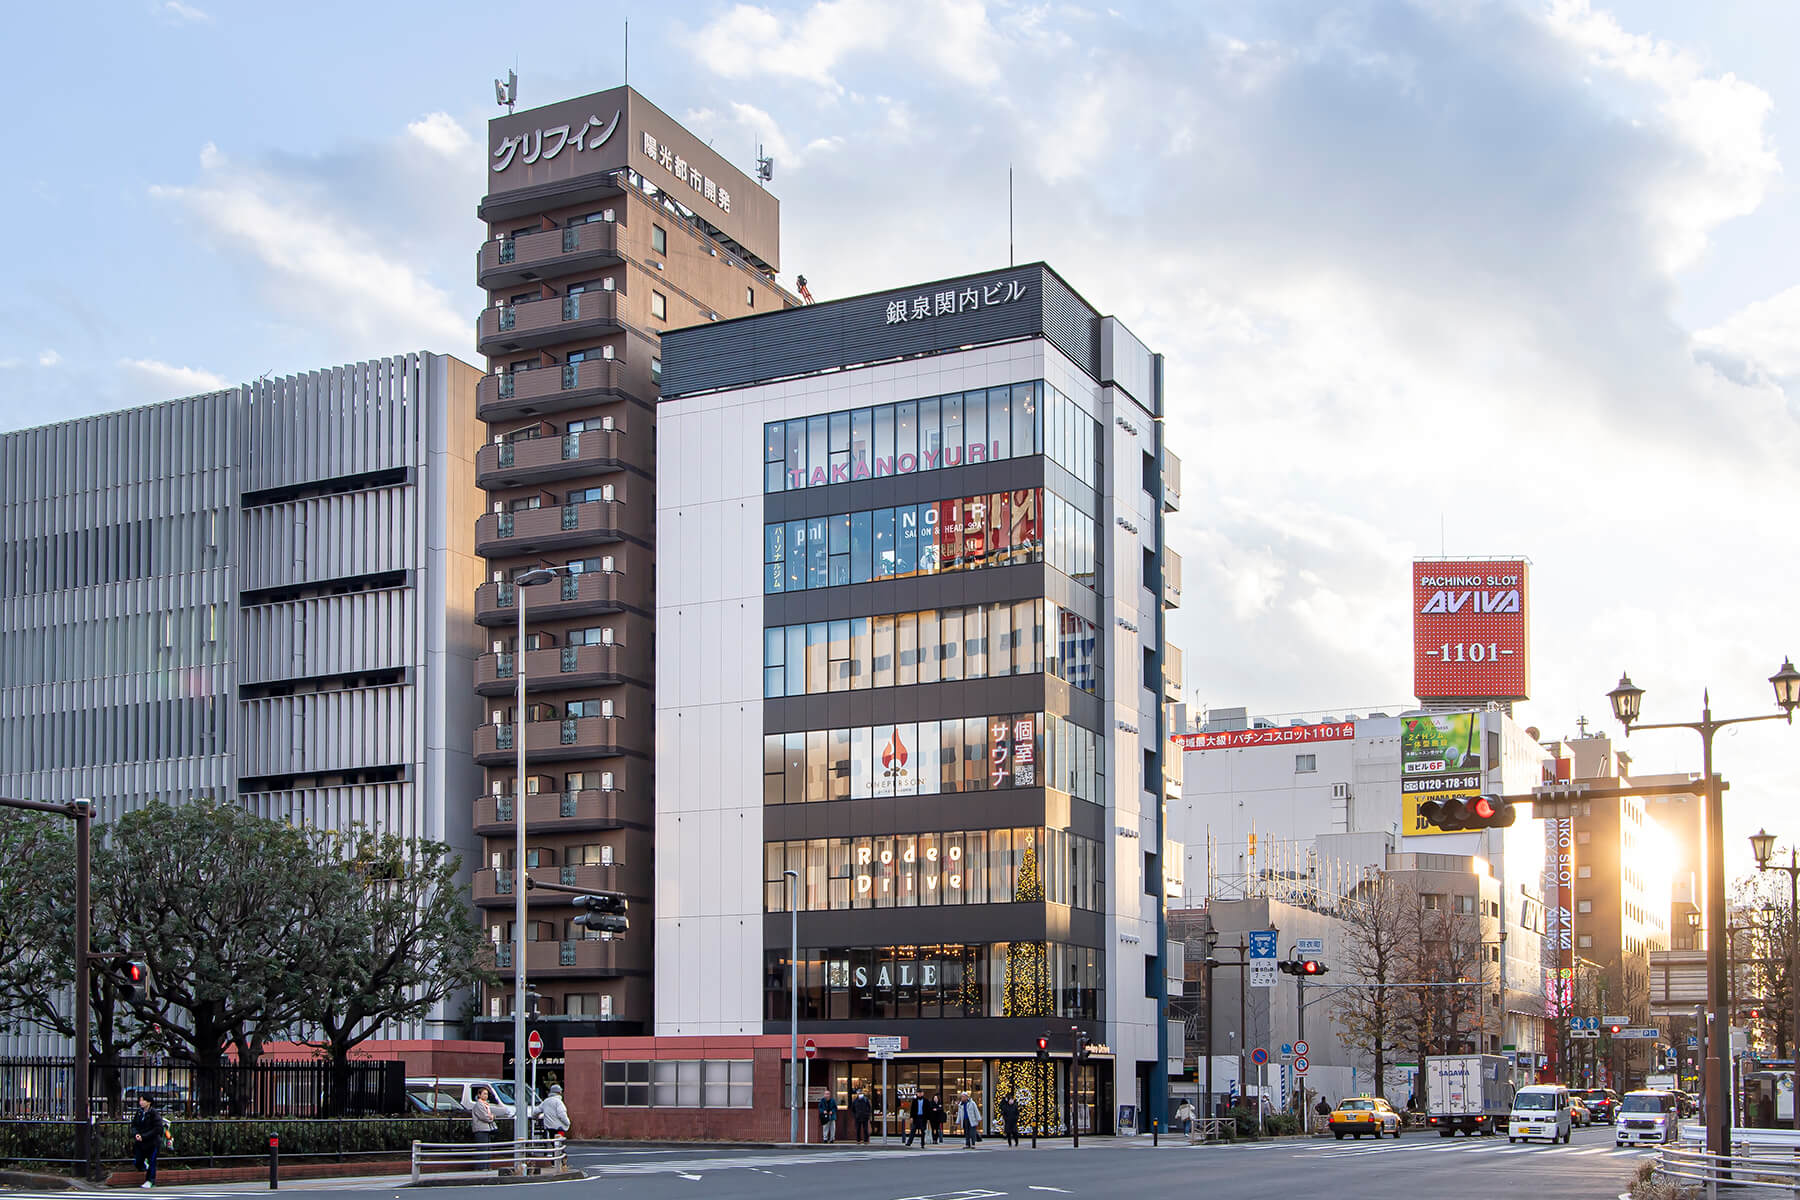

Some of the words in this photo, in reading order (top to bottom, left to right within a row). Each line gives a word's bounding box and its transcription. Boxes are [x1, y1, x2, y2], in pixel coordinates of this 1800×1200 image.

[492, 109, 621, 172] グリフィン
[642, 131, 731, 214] 陽光都市開発
[885, 280, 1026, 324] 銀泉関内ビル
[789, 440, 1001, 488] TAKANOYURI
[902, 503, 985, 528] NOIR
[944, 524, 963, 534] HEAD
[1421, 576, 1482, 586] PACHINKO
[1487, 575, 1518, 586] SLOT
[1420, 589, 1520, 613] AVIVA
[991, 722, 1009, 786] サウナ
[1014, 720, 1034, 763] 個室
[1419, 777, 1479, 790] 0120-178-161
[857, 844, 962, 866] Rodeo
[857, 872, 962, 894] Drive
[1559, 855, 1571, 889] SLOT
[855, 965, 937, 988] SALE
